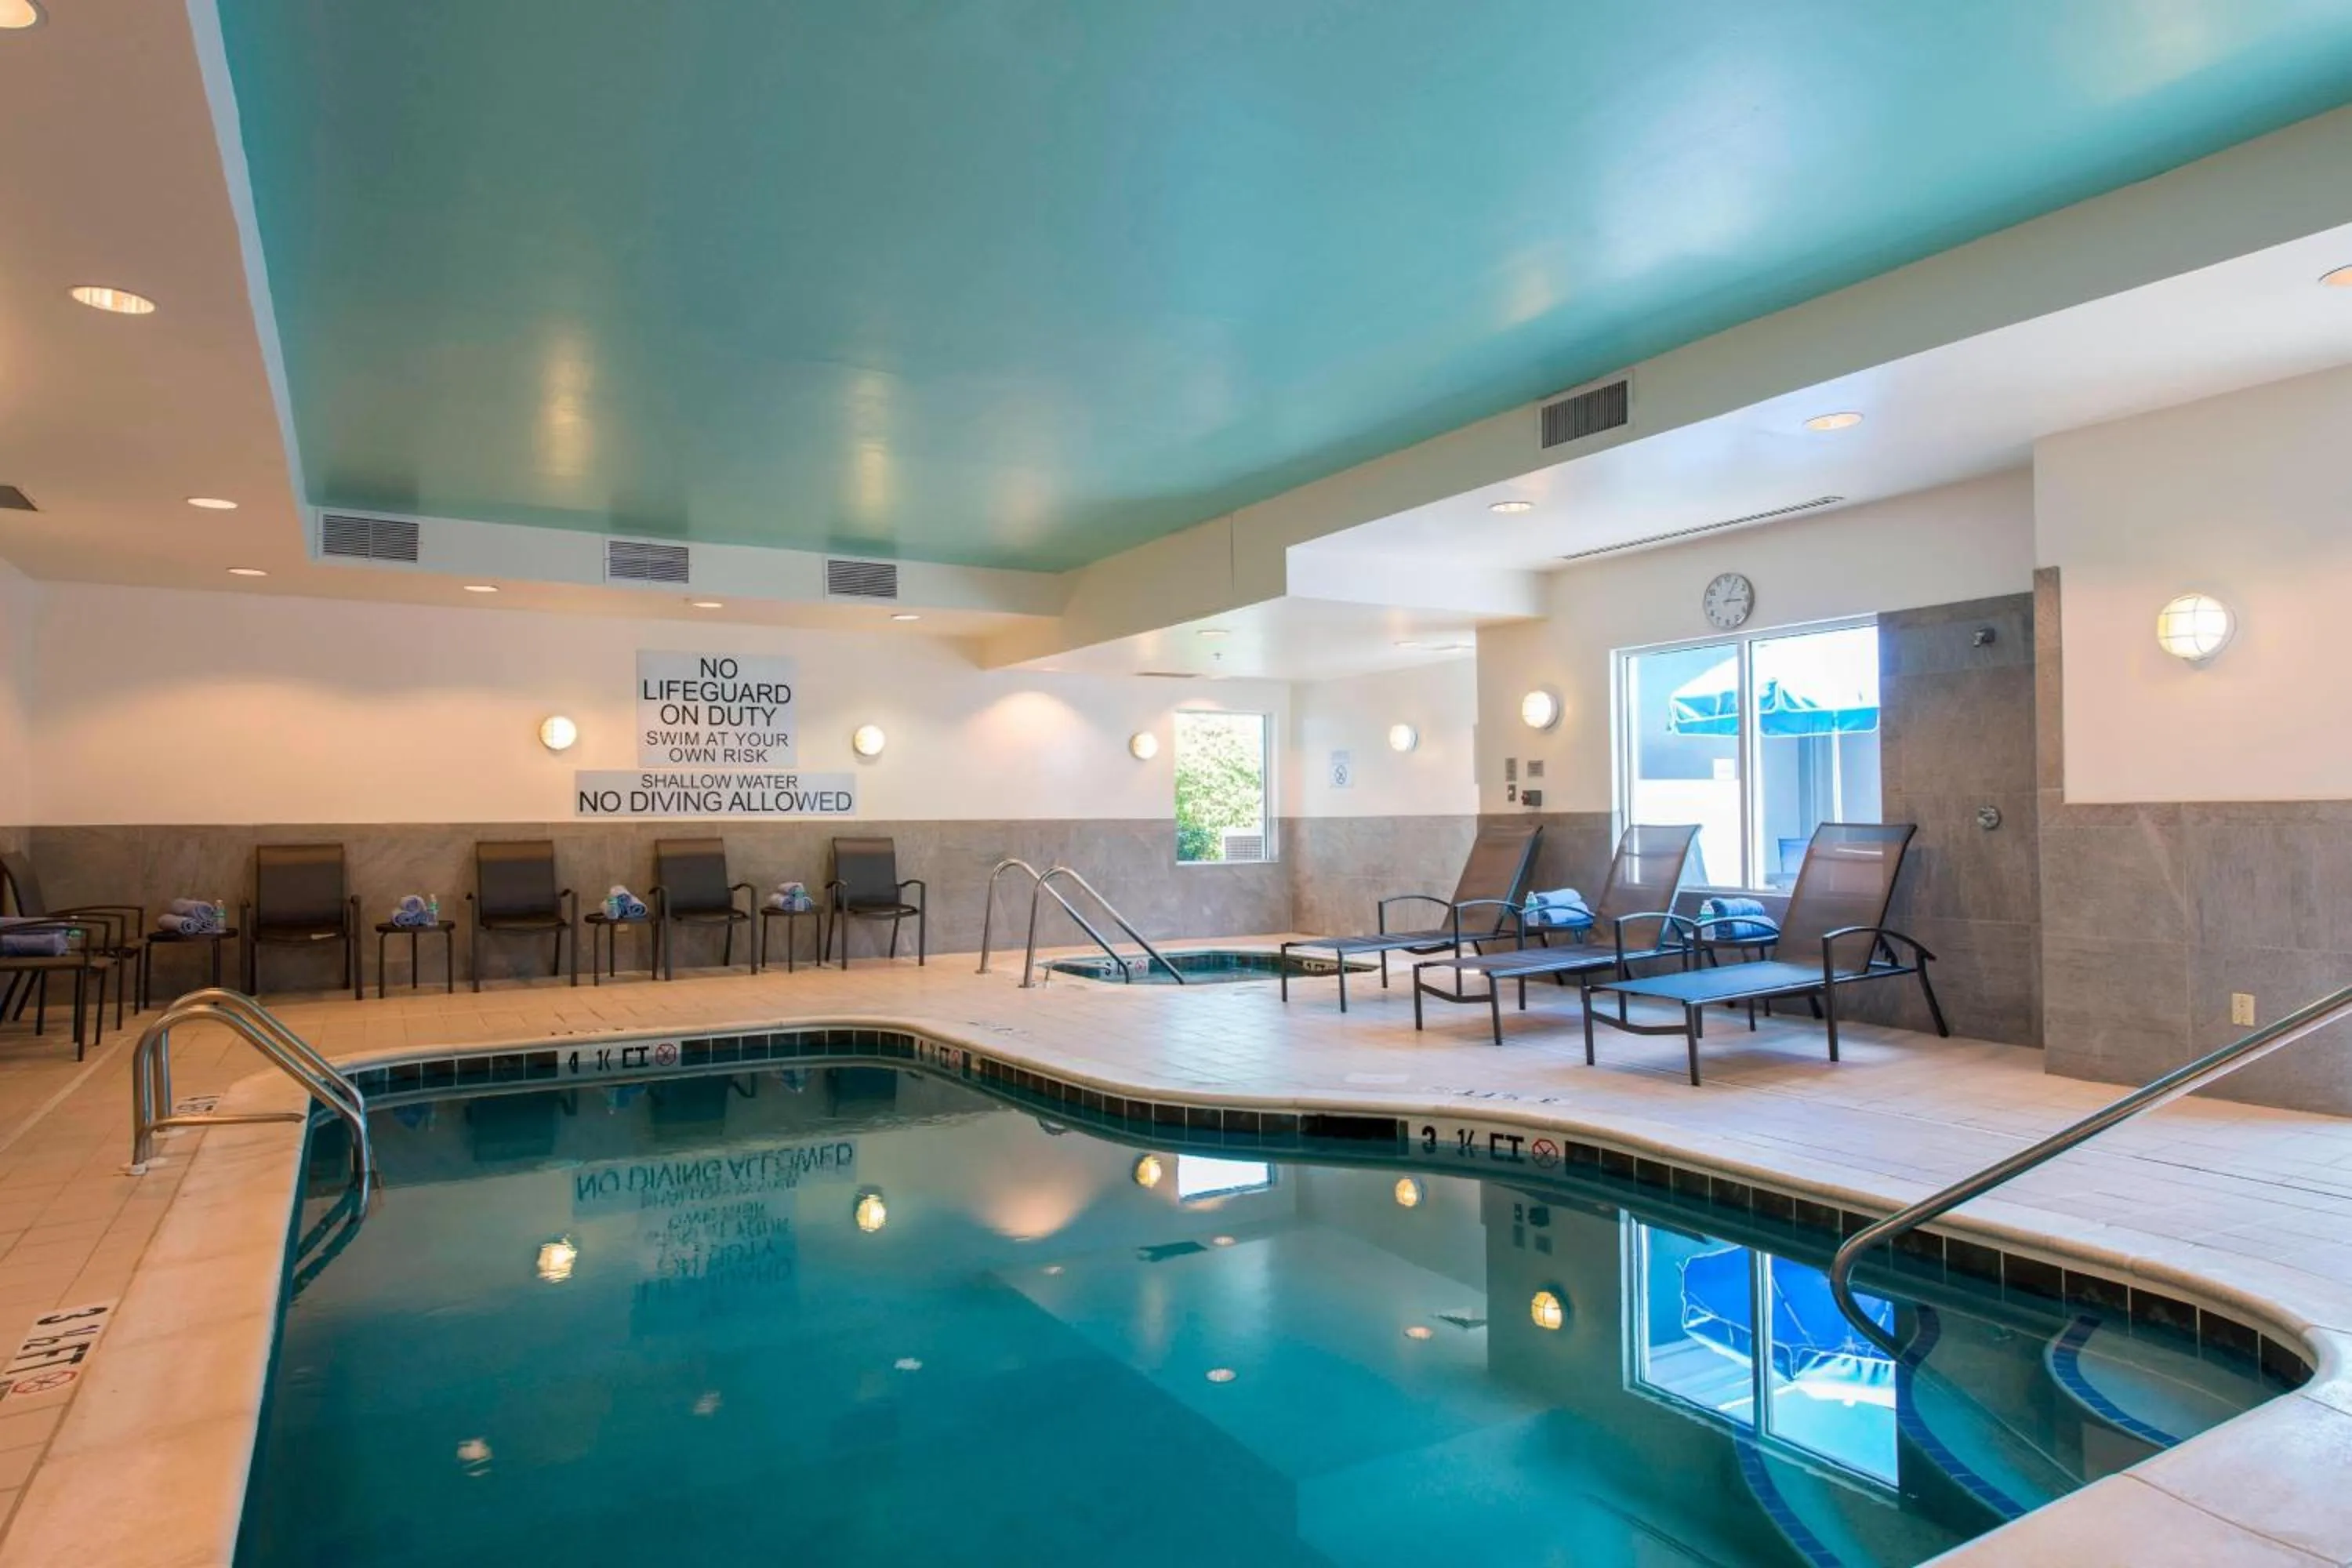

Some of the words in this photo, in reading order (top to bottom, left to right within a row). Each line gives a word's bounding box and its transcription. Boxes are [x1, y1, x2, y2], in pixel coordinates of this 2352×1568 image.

[700, 658, 738, 679] NO
[644, 679, 791, 704] LIFEGUARD
[661, 704, 699, 726] ON
[708, 706, 777, 727] DUTY
[646, 730, 699, 747] SWIM
[706, 732, 728, 747] AT
[735, 732, 789, 747] YOUR
[669, 747, 715, 763] OWN
[724, 748, 768, 763] RISK
[641, 774, 734, 789] SHALLOW
[737, 774, 798, 789] WATER
[579, 790, 620, 812] NO
[630, 791, 722, 812] DIVING
[729, 791, 852, 812] ALLOWED
